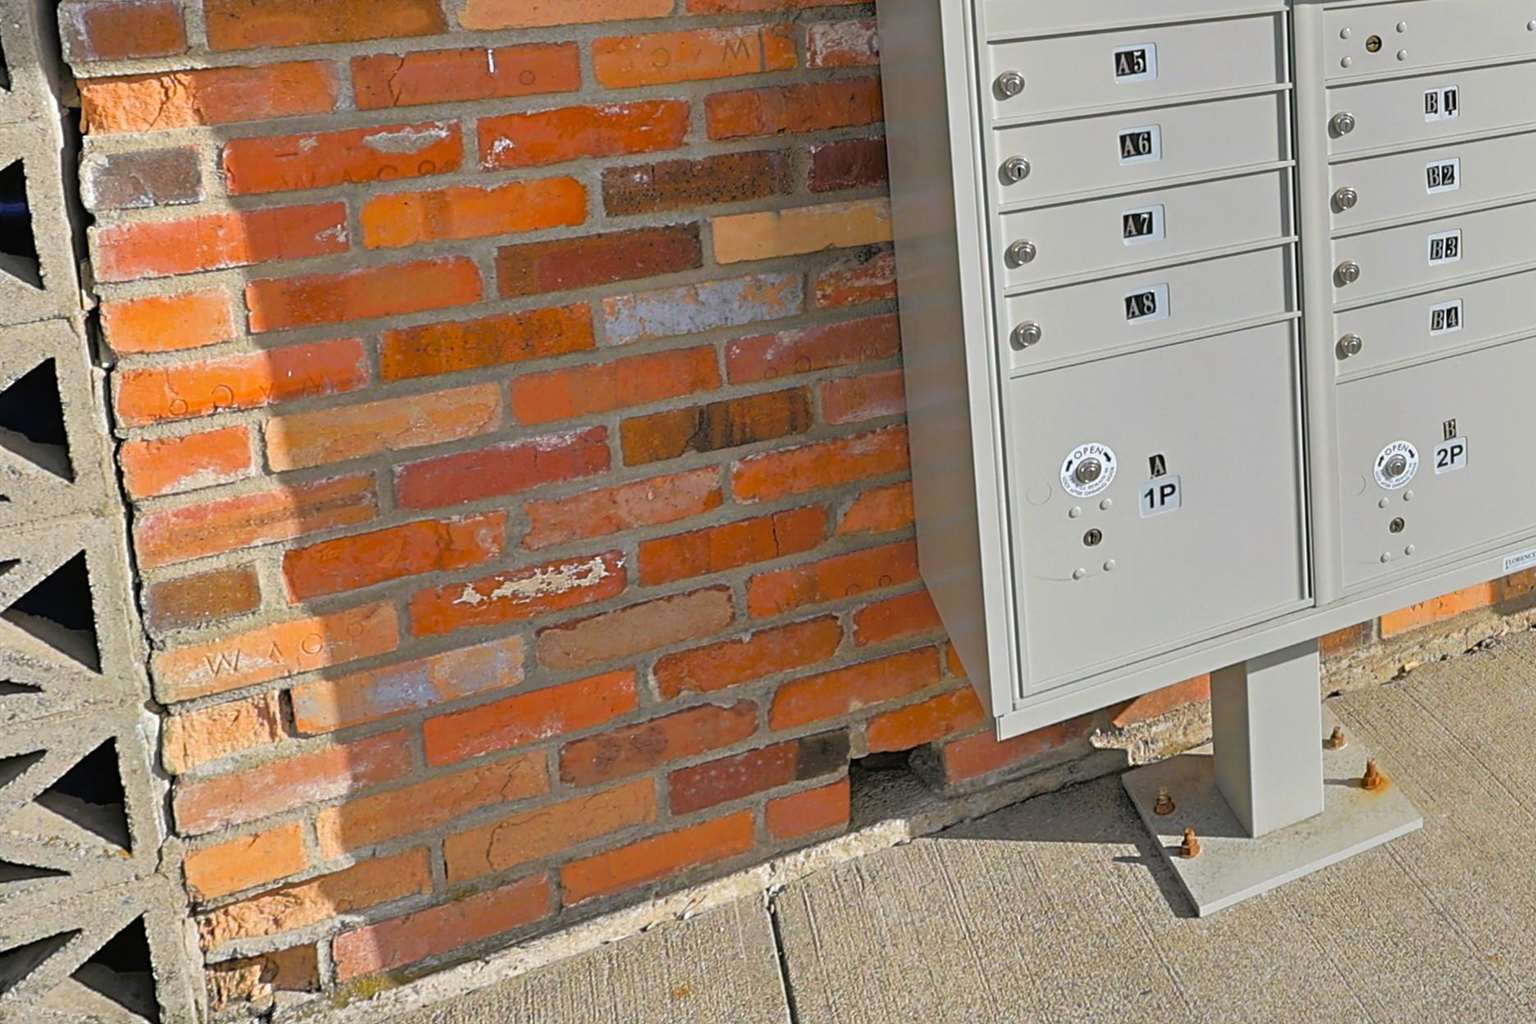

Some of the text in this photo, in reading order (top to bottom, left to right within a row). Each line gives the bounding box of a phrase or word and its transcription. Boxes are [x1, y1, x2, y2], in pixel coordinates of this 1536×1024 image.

[1117, 50, 1145, 75] A5
[1426, 90, 1455, 113] B1
[1122, 132, 1150, 157] A6
[1428, 165, 1453, 188] B2
[1125, 213, 1150, 237] A7
[1432, 237, 1456, 259] B3
[1128, 292, 1154, 318] A8
[1433, 307, 1457, 329] B4
[1444, 419, 1456, 440] B
[1074, 445, 1104, 460] OPEN
[1384, 443, 1409, 456] OPEN
[1436, 444, 1463, 469] 2P
[1152, 455, 1166, 477] A
[1143, 483, 1176, 509] 1P
